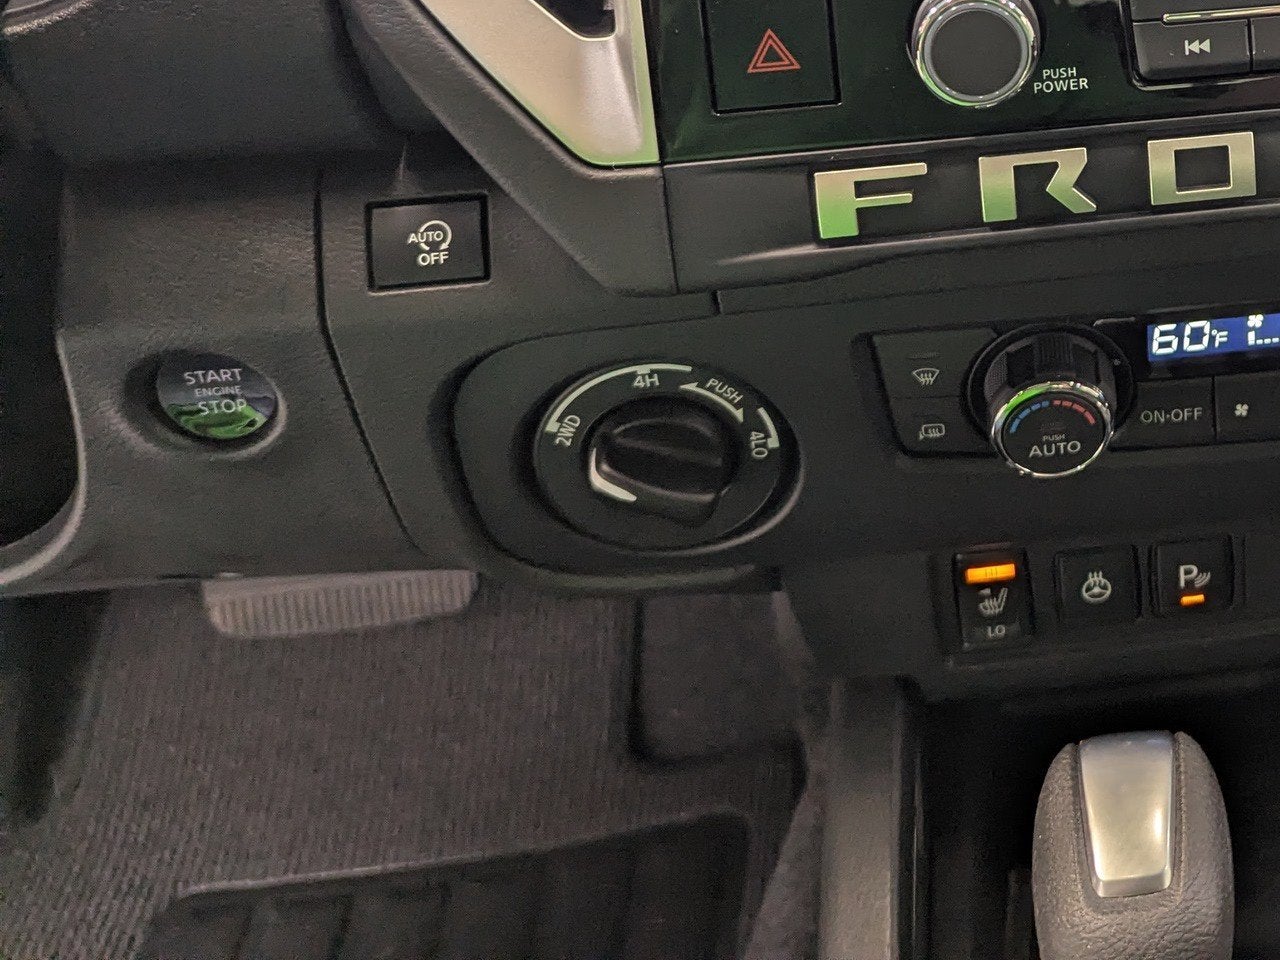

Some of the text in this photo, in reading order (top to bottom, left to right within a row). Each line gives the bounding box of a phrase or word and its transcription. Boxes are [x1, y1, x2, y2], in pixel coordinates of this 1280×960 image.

[1043, 67, 1077, 80] PUSH
[1033, 78, 1089, 94] POWER
[408, 230, 444, 245] AUTO
[418, 251, 449, 267] OFF
[184, 368, 242, 386] START
[632, 374, 660, 388] 4H
[195, 385, 243, 398] ENGINE
[706, 378, 744, 404] PUSH
[198, 399, 247, 416] STOP
[555, 414, 581, 447] 2WD
[750, 430, 768, 460] 4LO
[1029, 440, 1081, 458] AUTO
